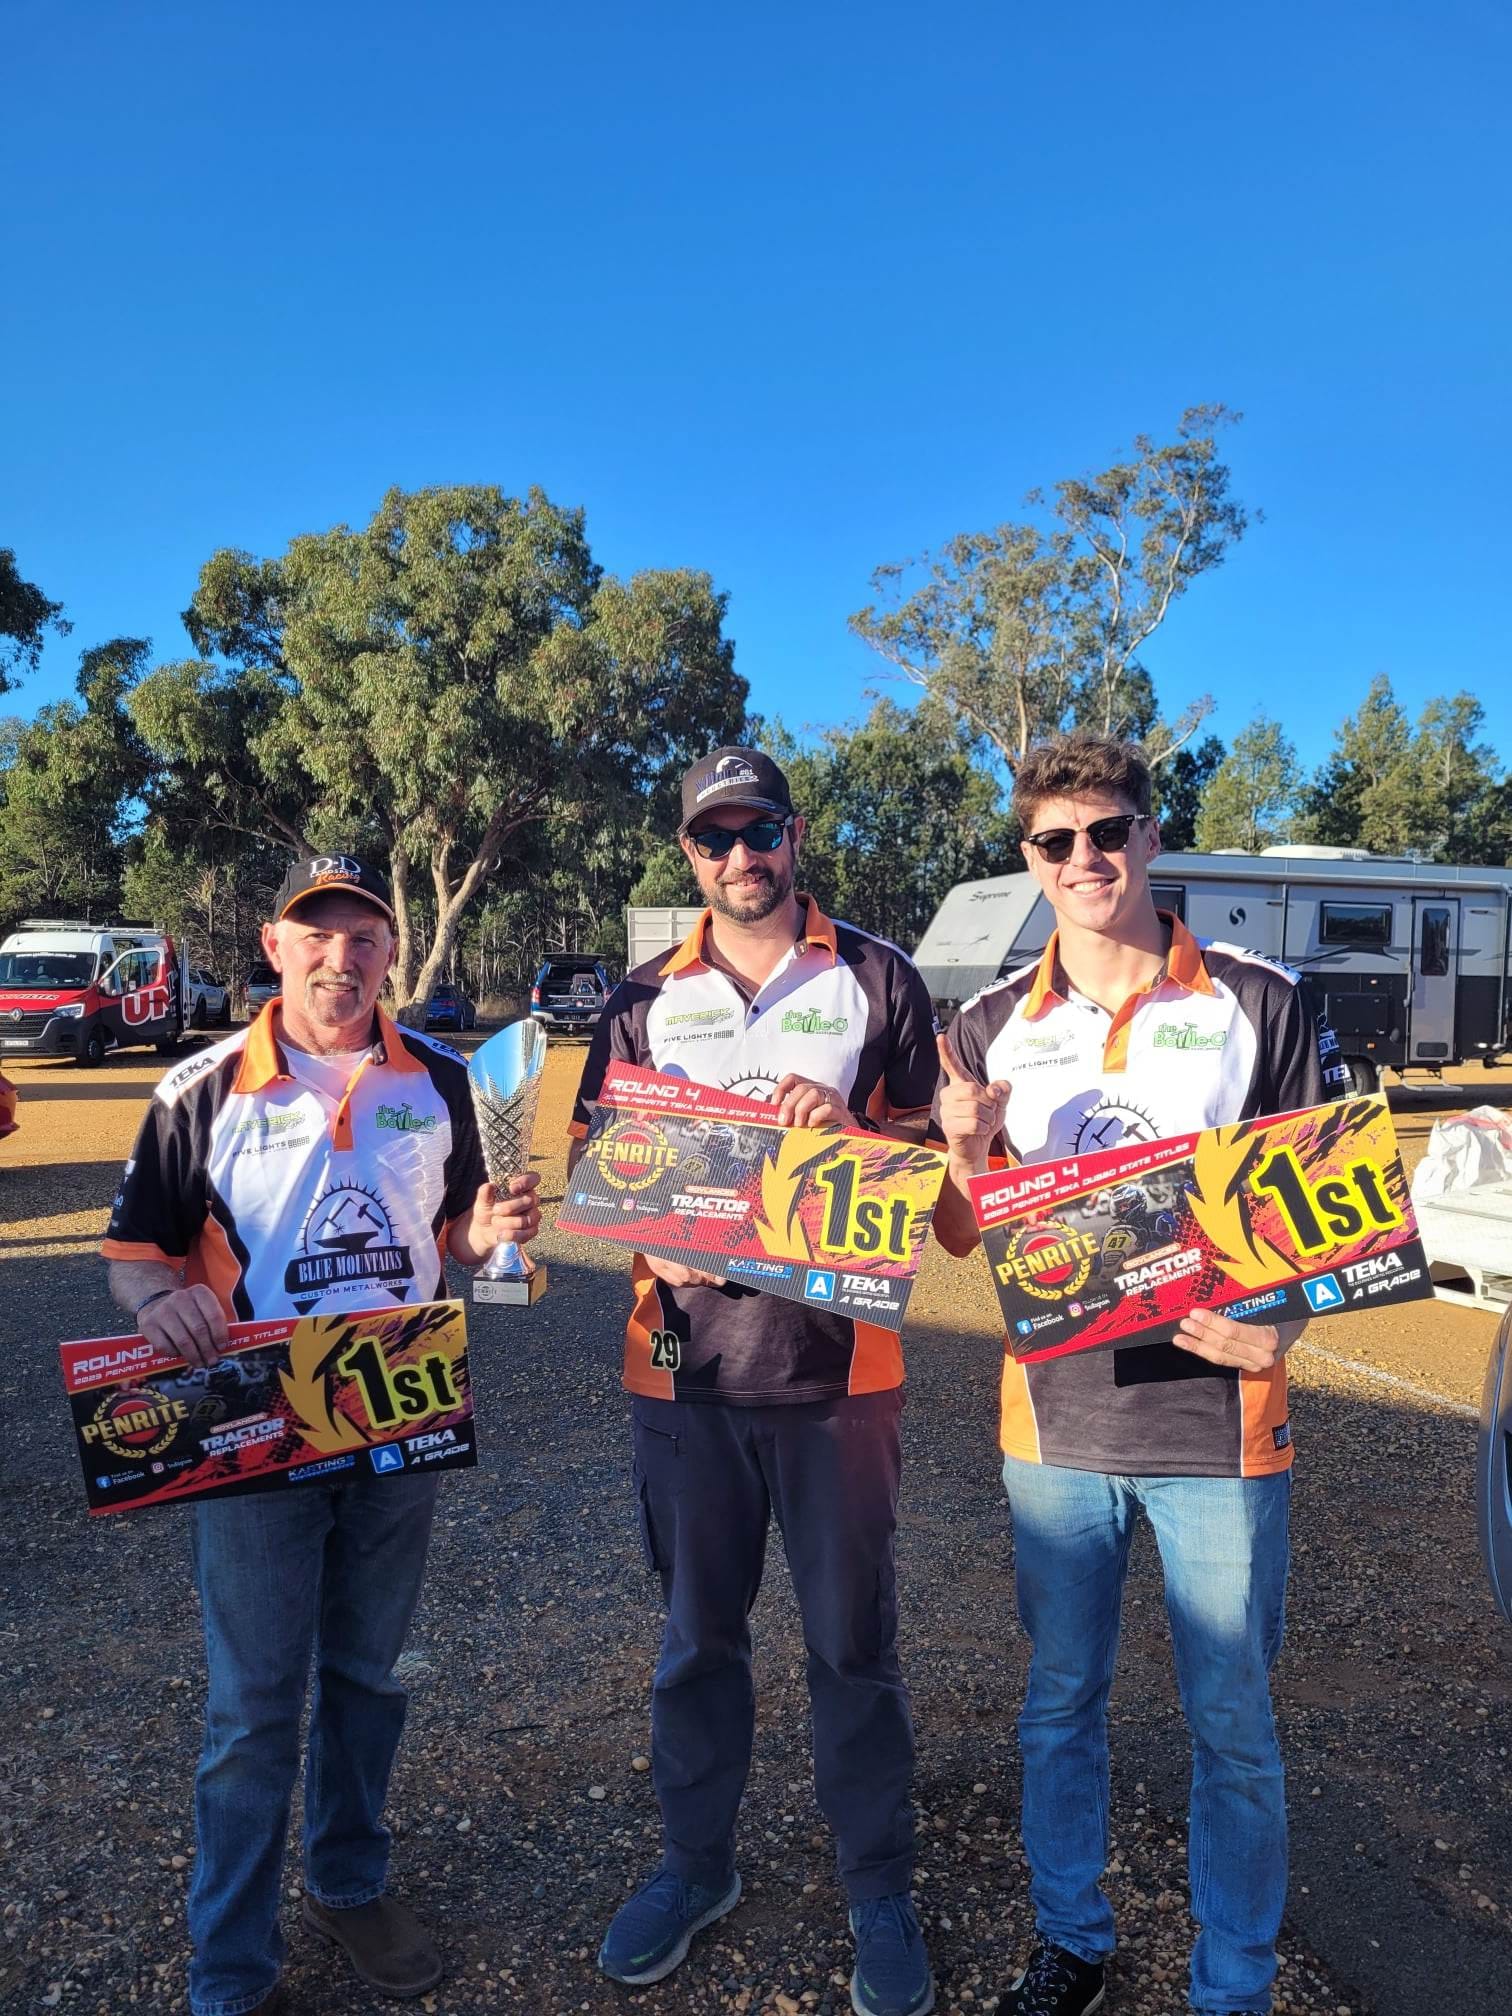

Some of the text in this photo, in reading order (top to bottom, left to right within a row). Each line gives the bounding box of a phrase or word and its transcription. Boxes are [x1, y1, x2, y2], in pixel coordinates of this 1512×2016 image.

[968, 891, 1012, 902] Supreme
[666, 1008, 730, 1026] MAVERICK
[664, 1035, 681, 1043] FIVE
[684, 1032, 712, 1040] LIGHTS
[169, 1058, 215, 1087] TEKA
[1029, 1058, 1058, 1067] LIGHTS
[608, 1079, 700, 1100] ROUND 4
[630, 1096, 667, 1107] PENRITE
[670, 1101, 693, 1110] TEKA
[695, 1104, 726, 1114] DUBBO
[727, 1109, 757, 1118] STATE
[759, 1113, 780, 1121] TITL
[233, 1148, 252, 1158] FIVE
[254, 1141, 286, 1153] LIGHTS
[586, 1140, 680, 1167] PENRITE
[981, 1163, 1079, 1210] ROUND 4
[983, 1142, 1190, 1221] 2023 PENRITE TEKA DUBBO STATE TITLES
[671, 1194, 751, 1213] TRACTOR
[819, 1157, 912, 1258] 1st
[1253, 1149, 1399, 1253] 1st
[674, 1209, 744, 1221] REPLACEMENTS
[1107, 1236, 1125, 1249] 47
[298, 1251, 403, 1282] BLUE MOUNTAINS
[728, 1259, 784, 1273] KARTING
[995, 1232, 1100, 1285] PENRITE
[1113, 1248, 1202, 1290] TRACTOR
[1341, 1252, 1402, 1283] TEKA
[300, 1280, 402, 1299] CUSTOM METALWORKS
[810, 1277, 828, 1295] A
[842, 1274, 890, 1294] TEKA
[1126, 1263, 1202, 1296] REPLACEMENTS
[1353, 1269, 1421, 1299] A GRADE
[839, 1295, 900, 1311] A GRADE
[1316, 1283, 1337, 1304] A
[1033, 1314, 1064, 1329] Facebook
[73, 1344, 154, 1375] ROUND
[74, 1373, 103, 1385] 2023
[105, 1362, 148, 1377] PENRITE
[254, 1327, 288, 1341] TITLES
[651, 1330, 679, 1370] 29
[340, 1337, 459, 1426] 1st
[81, 1400, 189, 1444] PENRITE
[199, 1418, 285, 1451] TRACTOR
[209, 1431, 284, 1457] REPLACEMENTS
[405, 1429, 457, 1452] TEKA
[380, 1451, 398, 1468] A
[411, 1456, 421, 1465] A
[424, 1443, 470, 1460] GRADE
[113, 1472, 144, 1484] Facebook
[288, 1457, 346, 1476] KARTING
